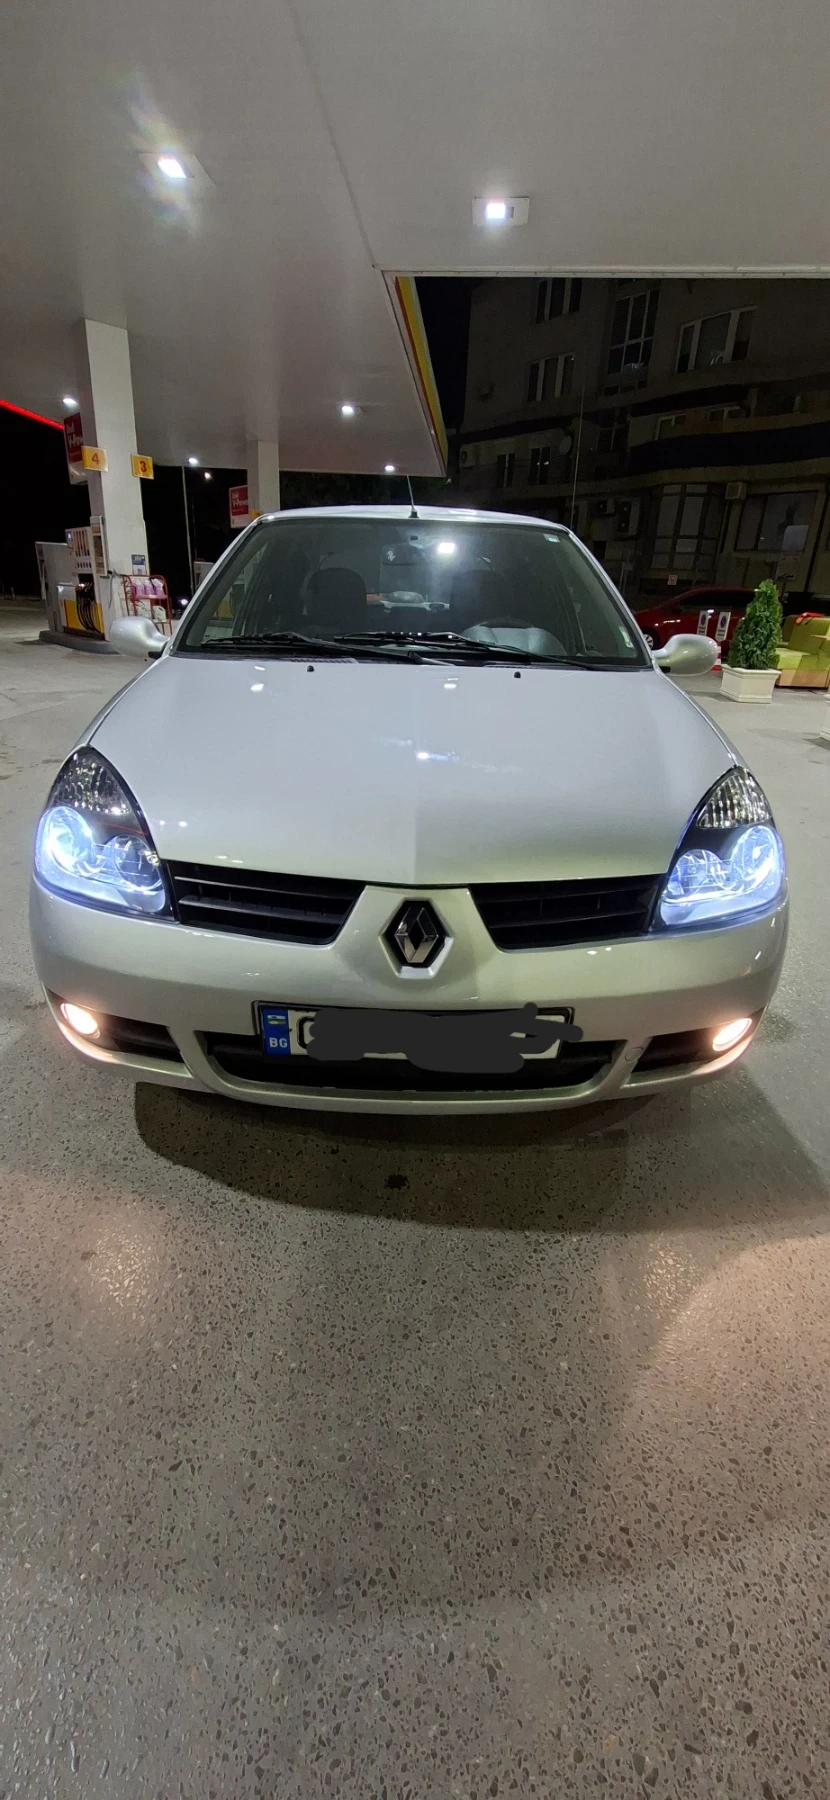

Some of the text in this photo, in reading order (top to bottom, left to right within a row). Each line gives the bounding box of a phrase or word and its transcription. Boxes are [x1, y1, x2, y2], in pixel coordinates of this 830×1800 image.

[92, 453, 100, 466] 4
[140, 461, 147, 473] 3
[269, 1037, 288, 1048] BG
